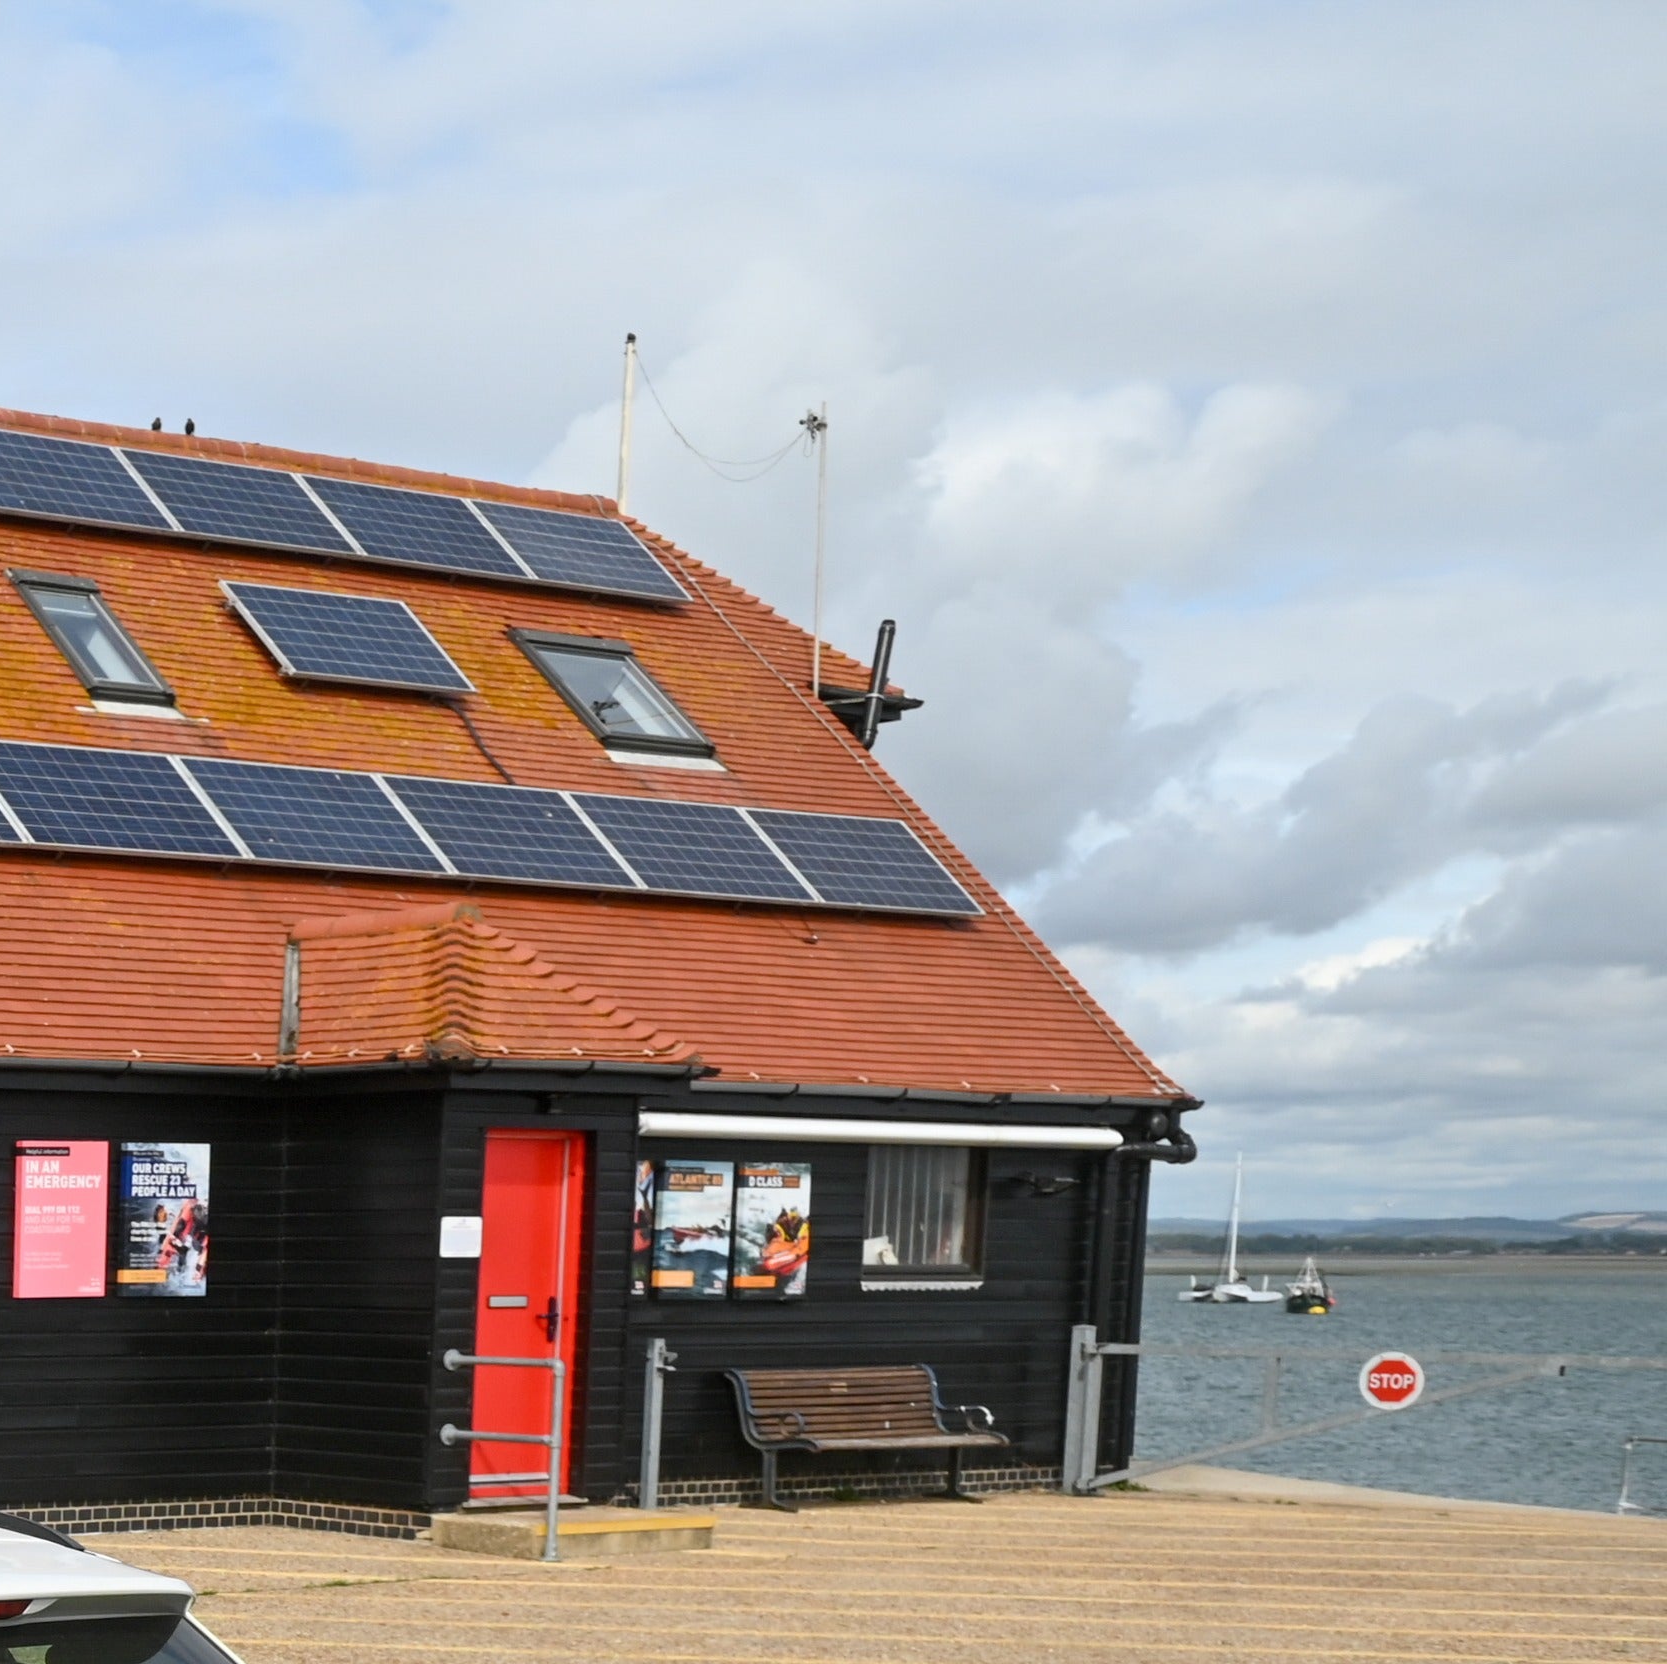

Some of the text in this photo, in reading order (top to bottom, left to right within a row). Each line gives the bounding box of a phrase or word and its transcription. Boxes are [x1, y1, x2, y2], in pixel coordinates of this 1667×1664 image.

[25, 1160, 60, 1173] IN AN
[132, 1162, 186, 1174] OUR CREWS
[25, 1175, 101, 1189] EMERGENCY
[131, 1174, 181, 1185] RESCUE 23
[756, 1176, 783, 1187] CLASS
[131, 1186, 196, 1197] PEOPLE A DAY
[1369, 1372, 1414, 1390] STOP
